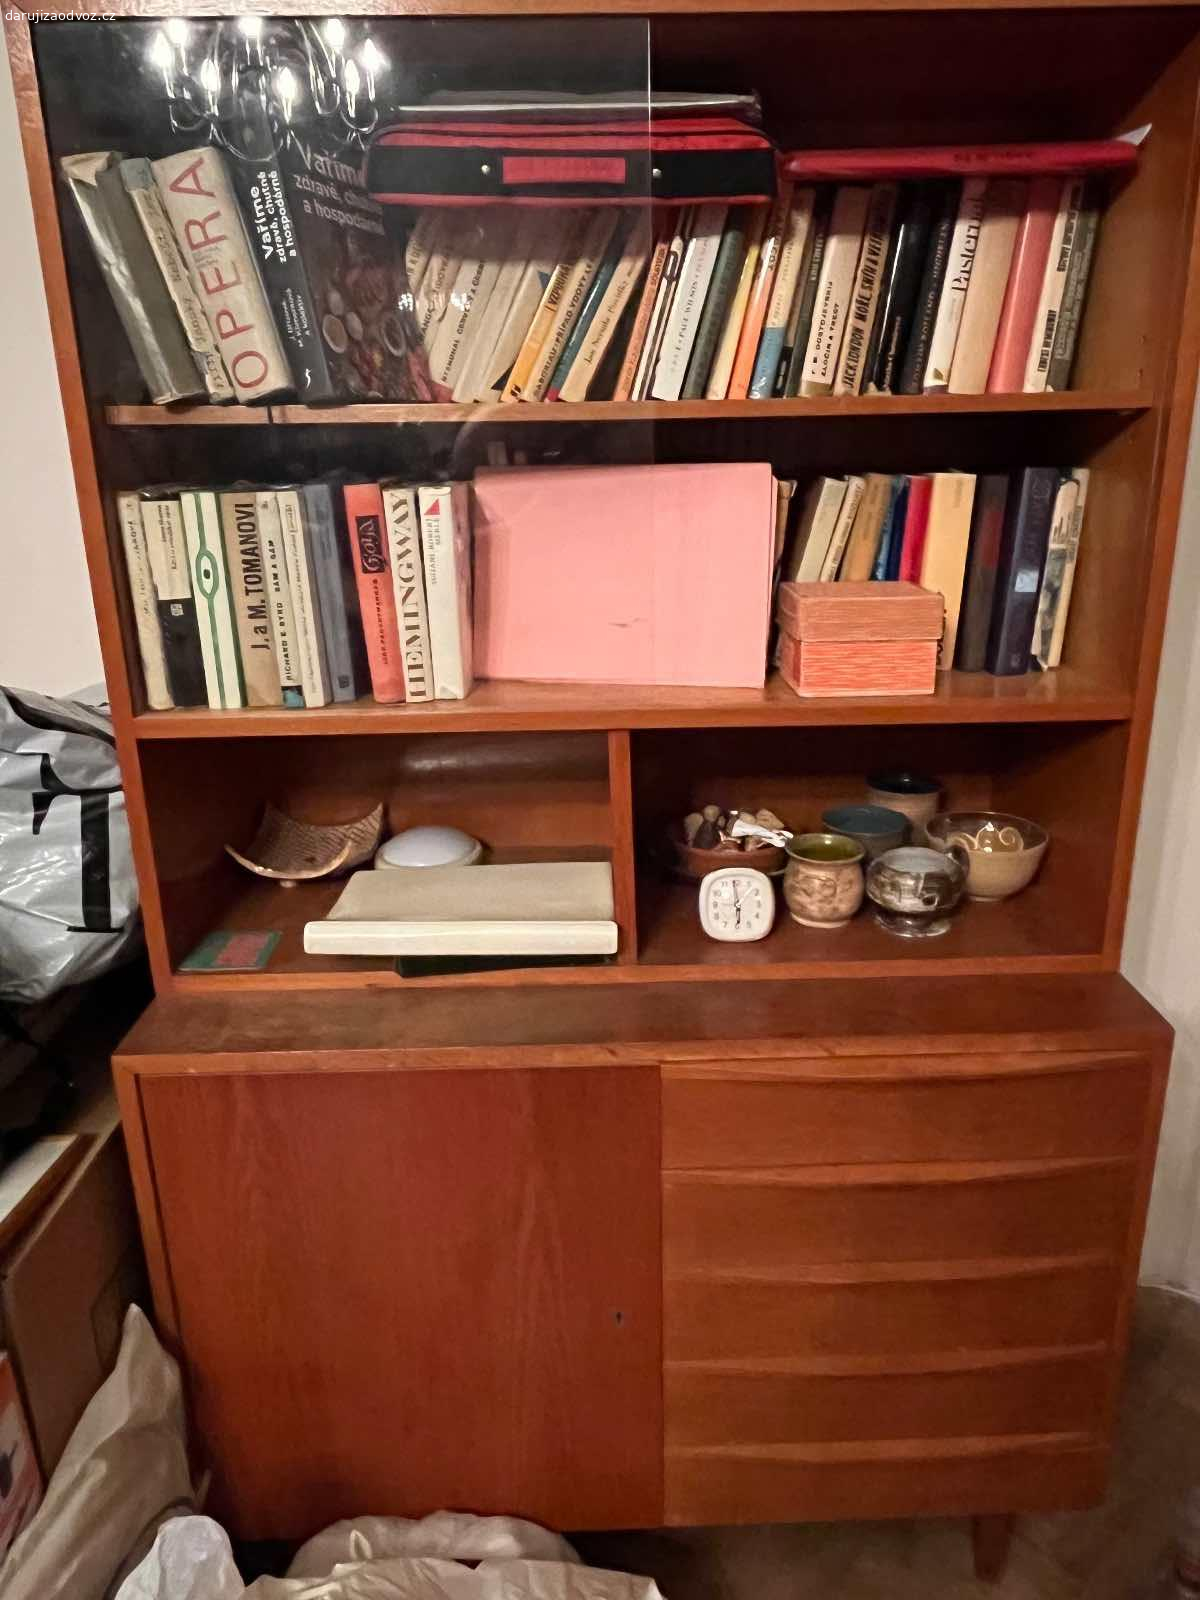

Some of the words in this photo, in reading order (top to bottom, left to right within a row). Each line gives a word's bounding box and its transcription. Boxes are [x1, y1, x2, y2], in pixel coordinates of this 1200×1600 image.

[250, 186, 274, 260] Vaříme
[168, 156, 272, 390] OPERA
[234, 503, 263, 597] TOMANOVI
[247, 599, 268, 620] M.
[276, 602, 285, 627] BYRD
[390, 491, 427, 698] HEMINGWAY
[250, 638, 270, 650] J.
[254, 624, 267, 635] a
[281, 640, 292, 681] RICHARD
